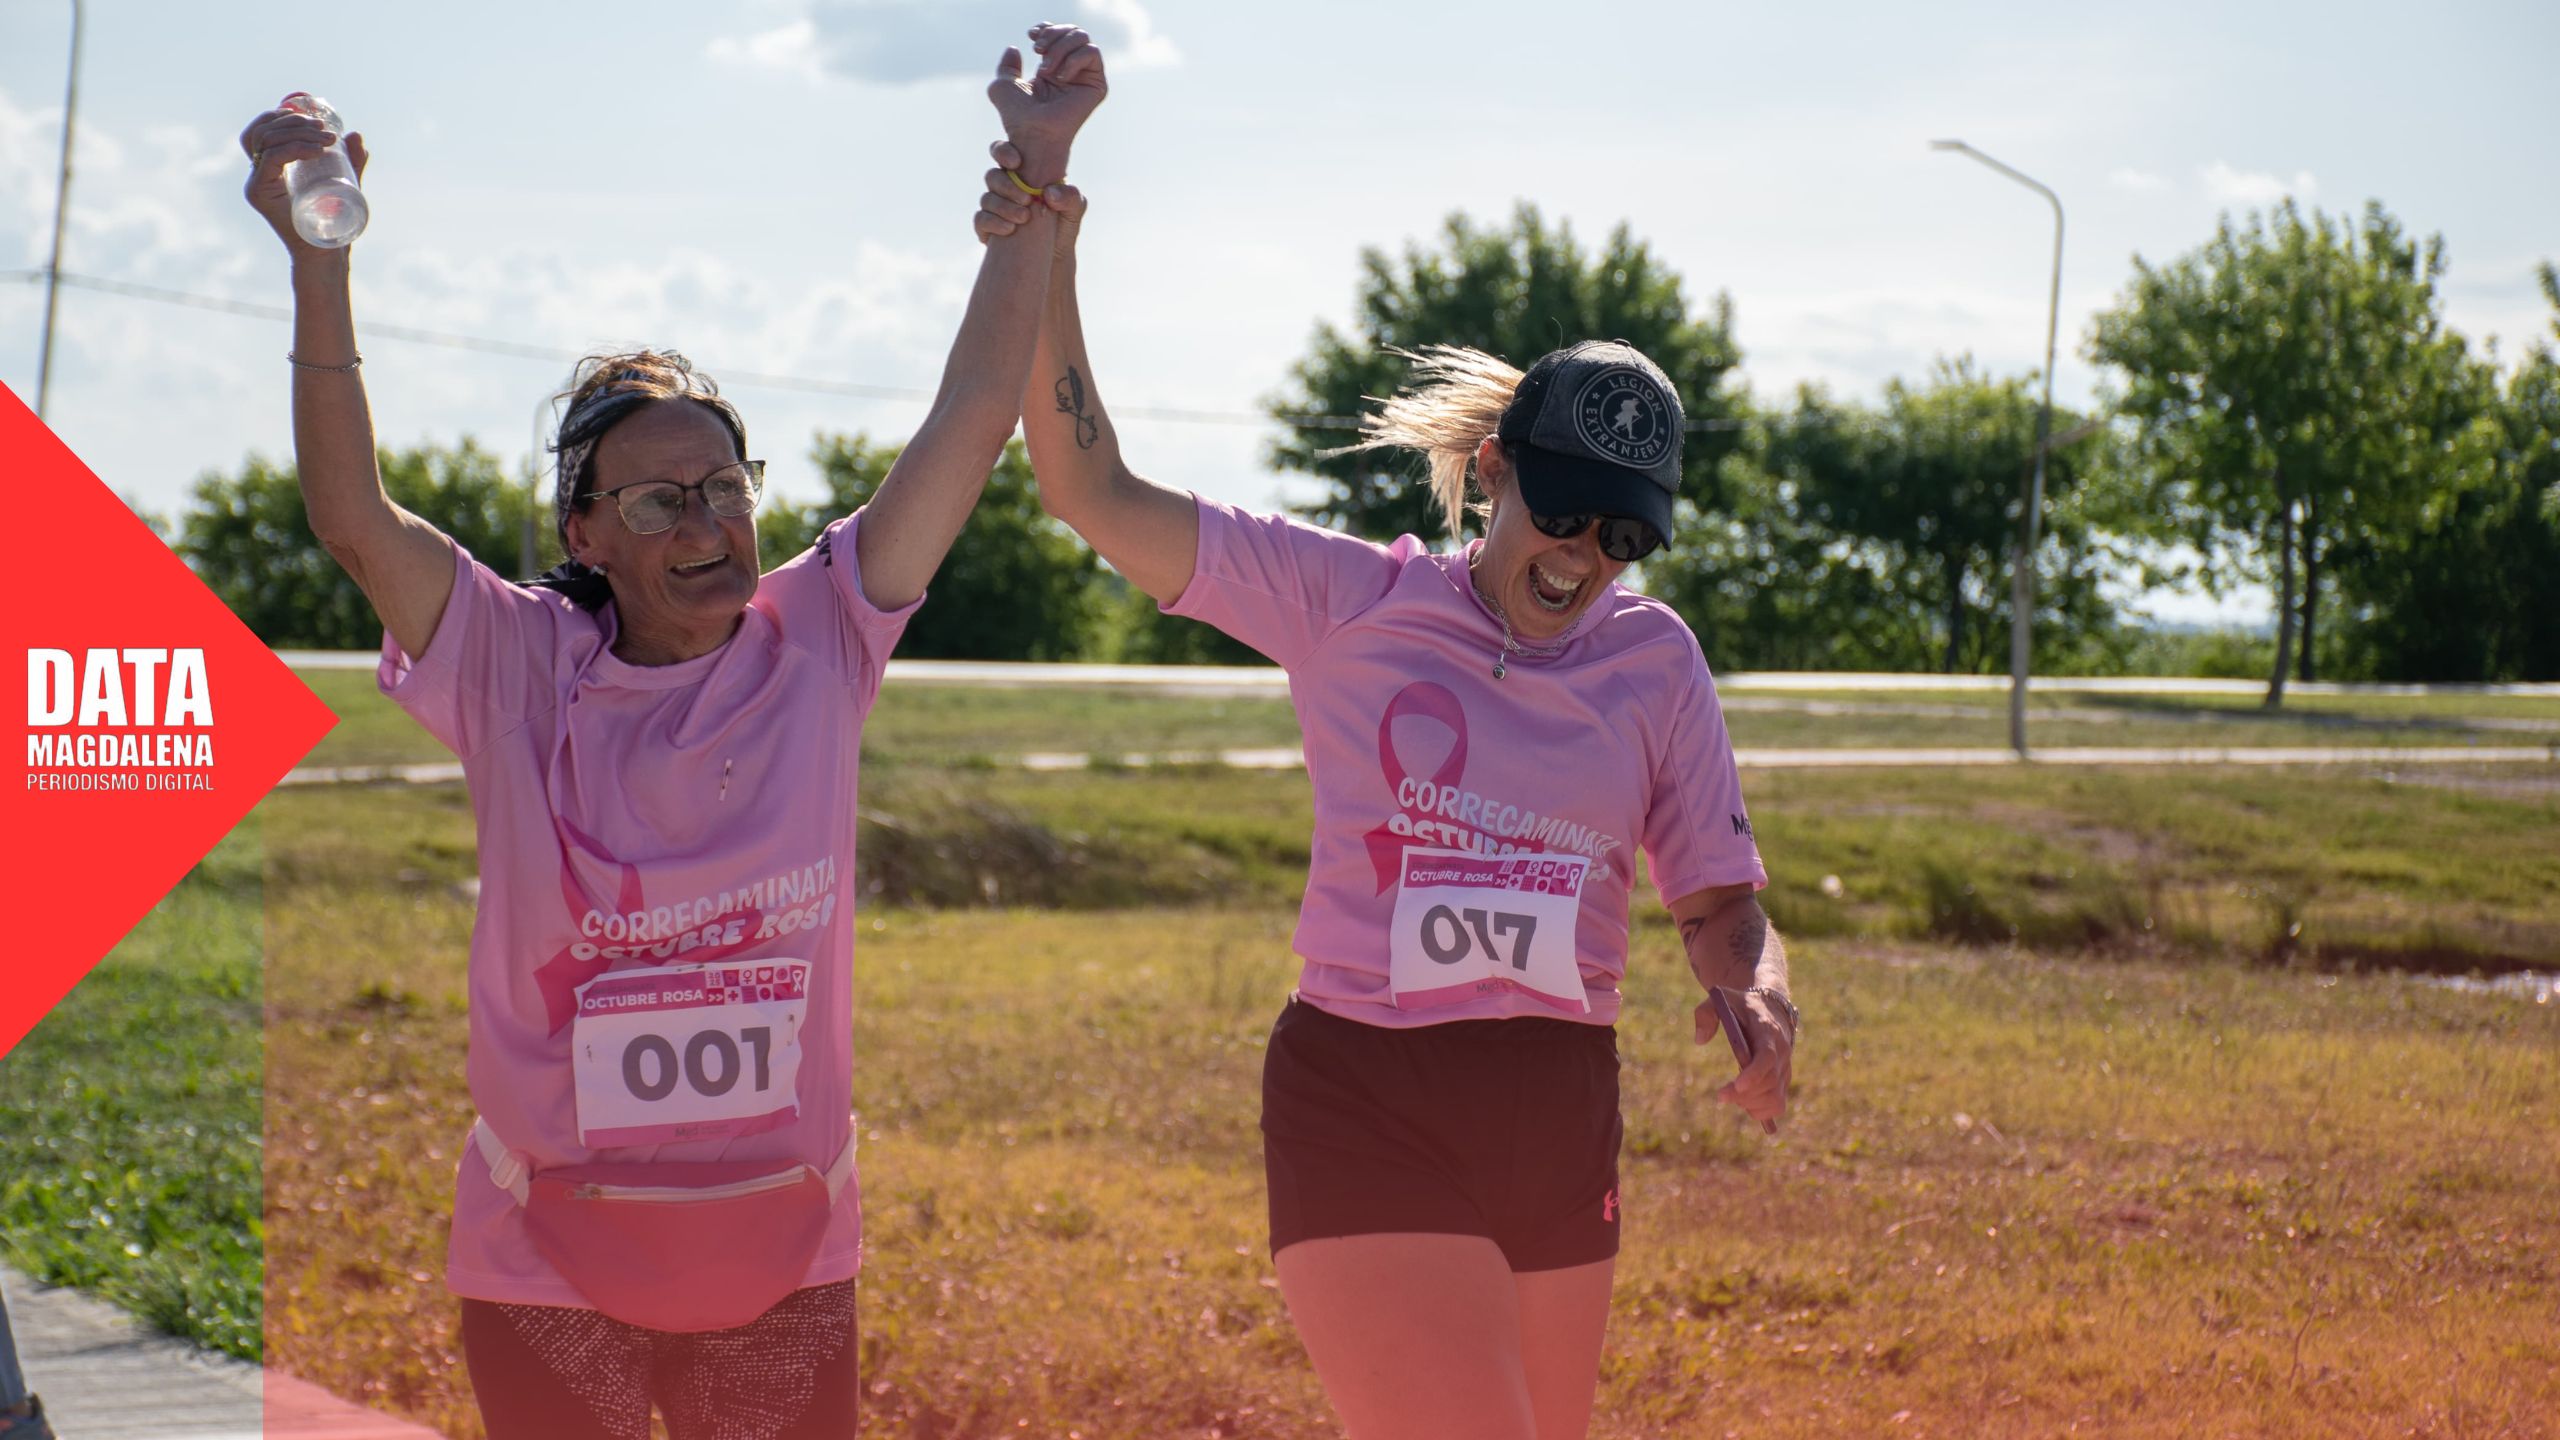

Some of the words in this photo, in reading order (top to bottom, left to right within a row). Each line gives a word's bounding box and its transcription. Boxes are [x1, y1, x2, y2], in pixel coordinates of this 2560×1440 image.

[1608, 376, 1663, 413] LEGION
[1586, 407, 1662, 459] EXTRANJERA
[1398, 777, 1622, 857] CORRECAMINATA
[581, 855, 835, 943] CORRECAMINATA
[1410, 870, 1461, 882] OCTUBRE
[1463, 872, 1493, 882] ROSA
[570, 919, 745, 961] OCTUBRE
[1420, 904, 1537, 971] 017
[584, 992, 657, 1010] OCTUBRE
[663, 988, 704, 1003] ROSA
[621, 1026, 770, 1102] 001
